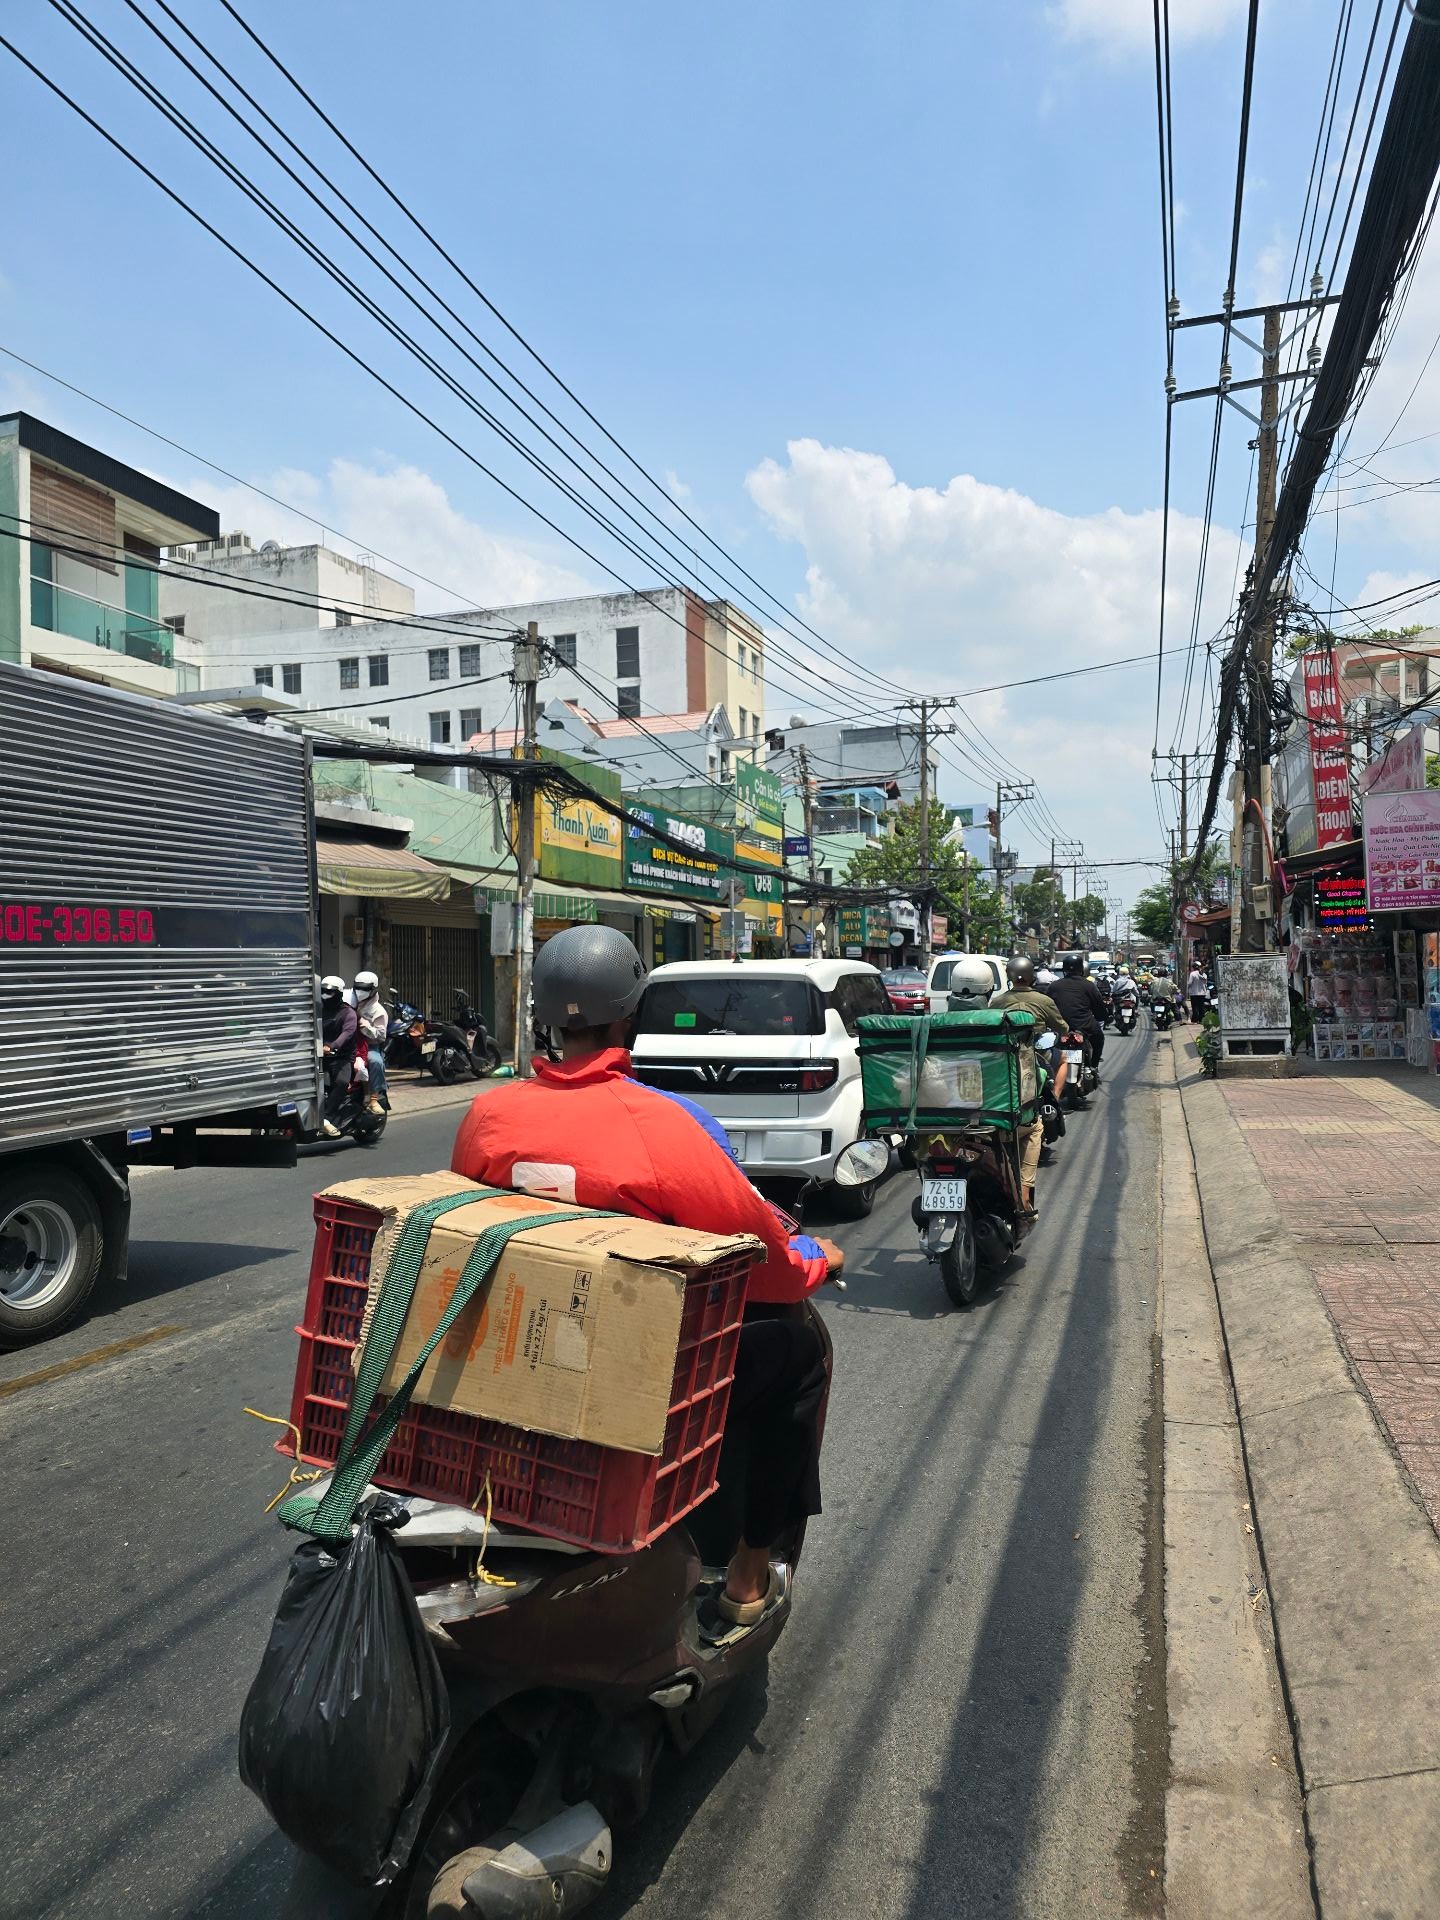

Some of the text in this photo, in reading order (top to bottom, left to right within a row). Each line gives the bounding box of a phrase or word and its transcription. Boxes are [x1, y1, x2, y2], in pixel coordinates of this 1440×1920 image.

[1306, 658, 1333, 677] MUA
[1310, 687, 1336, 707] BÁN
[1318, 776, 1347, 802] ĐIỆN
[1318, 810, 1350, 832] THOẠI
[1389, 826, 1404, 834] HOA
[1404, 823, 1425, 833] CHÍNH
[842, 911, 862, 919] MICA
[0, 904, 155, 943] 0E-336.50
[844, 922, 861, 931] ALU
[840, 934, 864, 942] DECAL
[929, 1182, 959, 1195] 72-G1
[925, 1195, 963, 1209] 489.59
